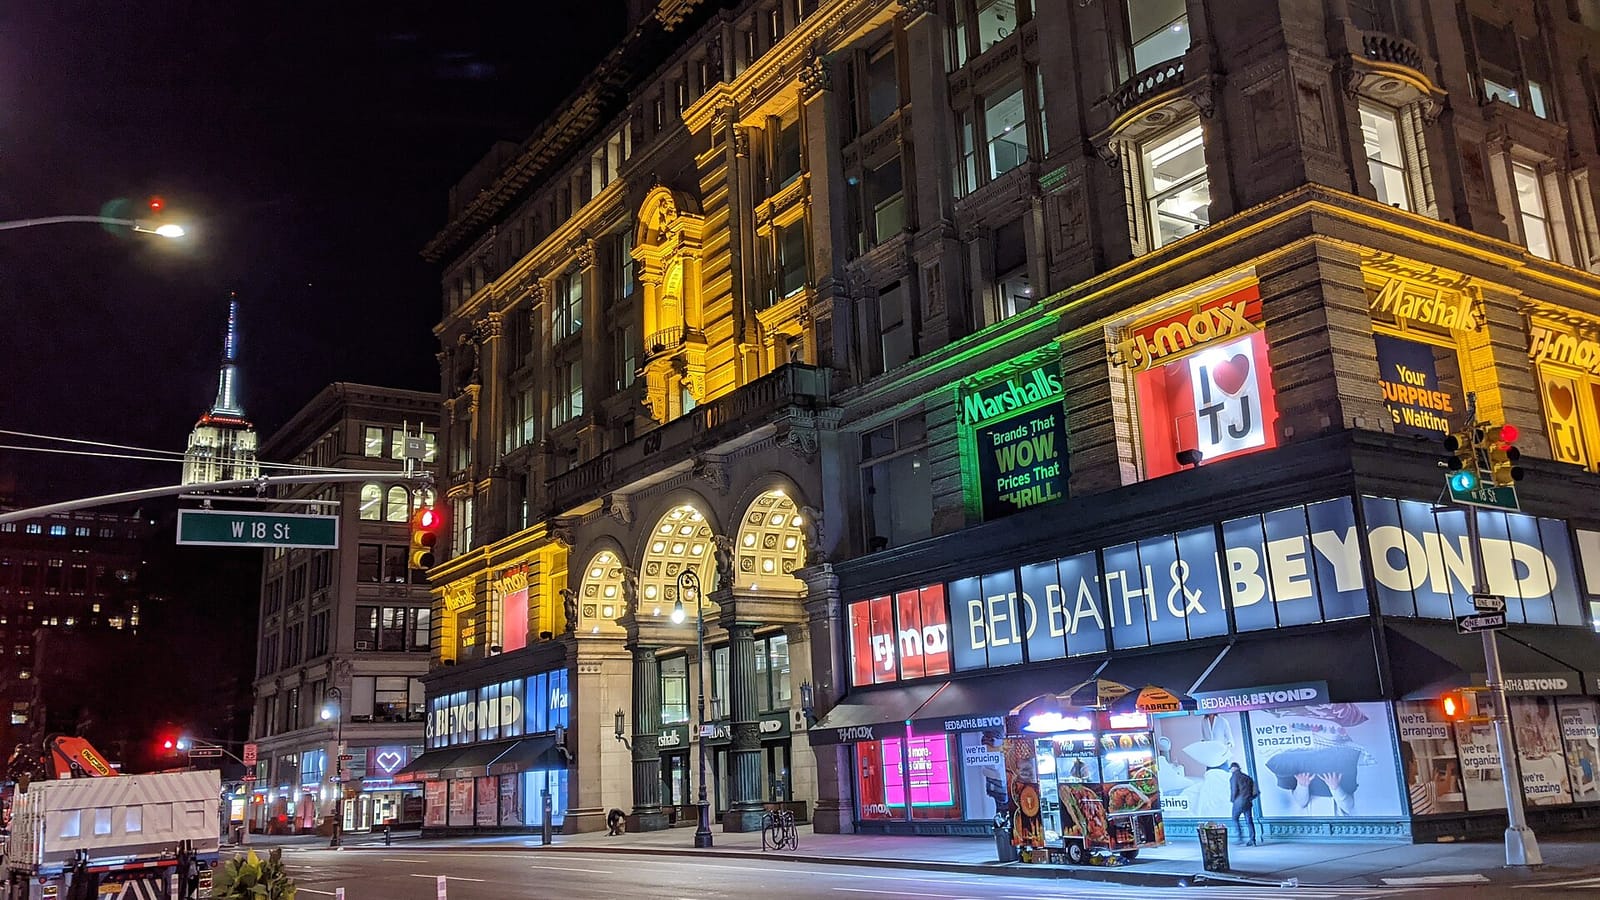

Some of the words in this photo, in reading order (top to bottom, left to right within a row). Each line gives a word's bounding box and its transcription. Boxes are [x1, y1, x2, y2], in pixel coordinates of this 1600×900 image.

[1370, 277, 1478, 332] Marshalls
[1395, 363, 1426, 387] Your
[1199, 365, 1212, 405] I
[964, 367, 1063, 426] Marshalls
[1377, 379, 1454, 413] SURPRISE
[1199, 395, 1252, 445] TJ
[1401, 406, 1450, 436] Waiting
[993, 425, 1028, 446] Brands
[1030, 414, 1055, 434] That
[994, 431, 1058, 474] WOW.
[997, 472, 1031, 492] Prices
[1032, 461, 1060, 481] That
[231, 521, 245, 538] W
[251, 522, 267, 539] 18
[273, 523, 291, 540] St
[967, 591, 1038, 650] BED
[1046, 564, 1159, 639] BATH
[1166, 560, 1207, 618] &
[1215, 526, 1557, 610] BEYOND
[1464, 619, 1479, 627] ONE
[1485, 617, 1500, 625] WAY
[1523, 678, 1568, 691] BEYOND
[1140, 702, 1178, 711] SABRETT
[1201, 698, 1218, 709] BED
[1219, 695, 1242, 708] BATH
[1250, 688, 1318, 705] BEYOND
[426, 712, 434, 739] &
[435, 695, 521, 737] BEYOND
[1400, 714, 1425, 724] we're
[1564, 716, 1583, 725] we're
[1256, 725, 1288, 735] we're
[1402, 724, 1447, 738] arranging
[1565, 725, 1597, 738] cleaning
[1257, 734, 1312, 747] snazzing
[965, 746, 986, 754] we're
[1462, 744, 1486, 754] we're
[966, 753, 1000, 764] sprucing
[1523, 773, 1544, 782] we're
[1525, 783, 1560, 797] snazzing
